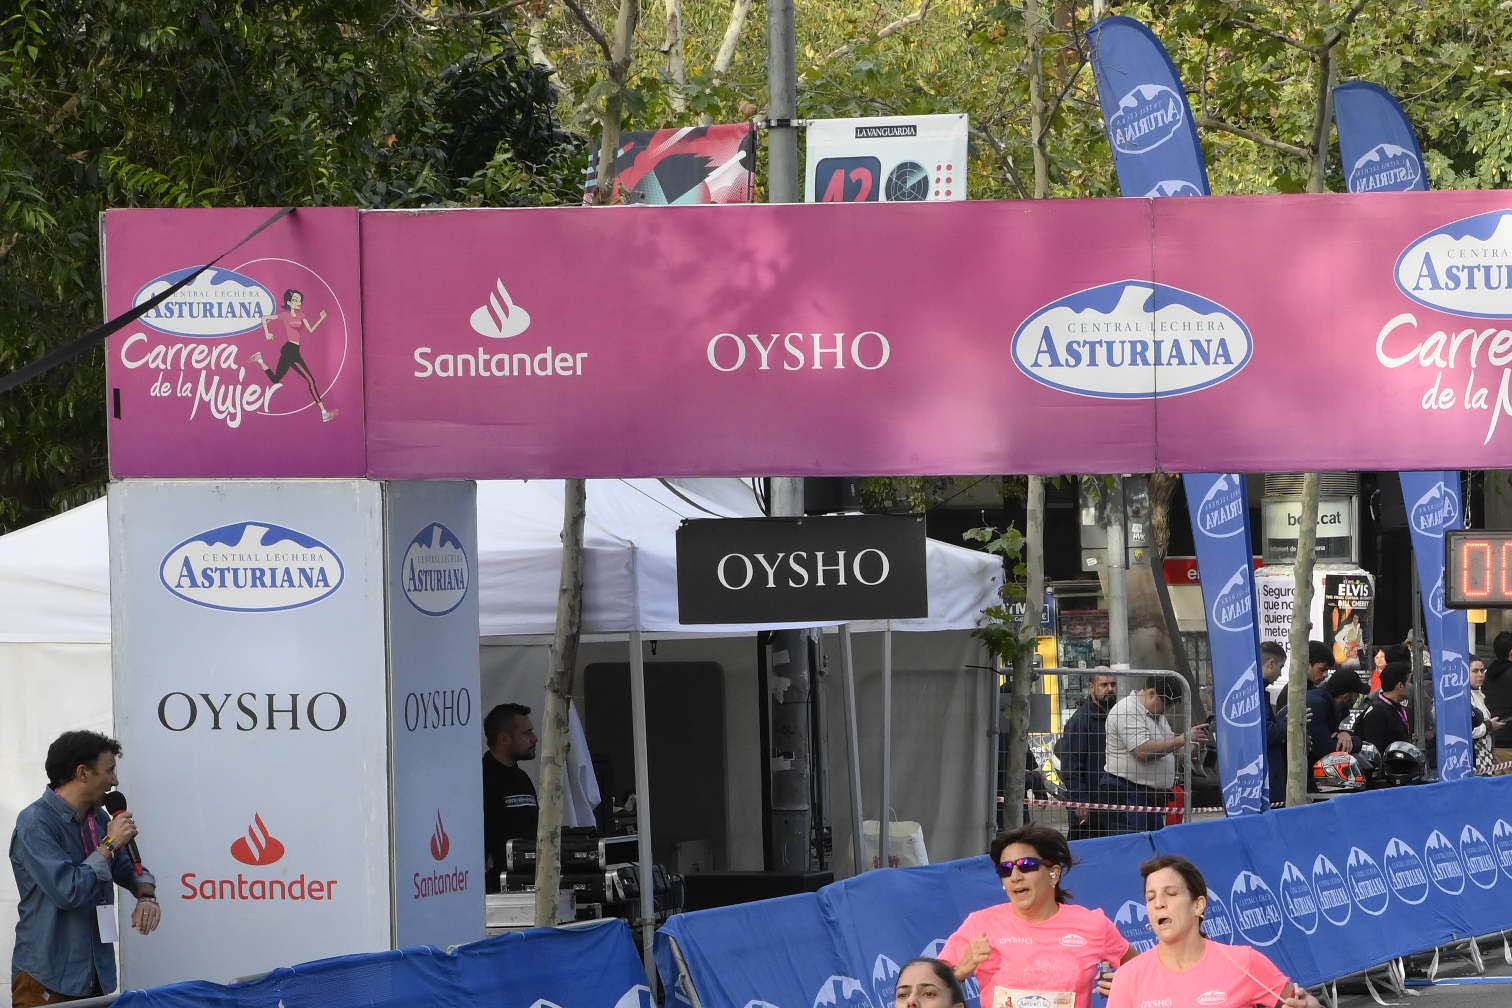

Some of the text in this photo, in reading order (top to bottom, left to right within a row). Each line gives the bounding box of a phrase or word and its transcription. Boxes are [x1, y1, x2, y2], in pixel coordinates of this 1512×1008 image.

[146, 292, 266, 320] ASTURIANA
[173, 289, 207, 299] ENTRAL
[1068, 320, 1227, 333] CENTRAL LECHERA
[121, 333, 238, 370] Carrera
[414, 346, 588, 377] Santander
[707, 331, 891, 372] OYSHO
[1030, 325, 1234, 368] ASTURIANA
[150, 367, 283, 428] de la Mujer
[1422, 378, 1454, 410] de
[1463, 373, 1488, 410] la
[174, 555, 331, 590] ASTURIANA
[202, 553, 325, 562] CENTRAL LECHERA
[717, 548, 890, 591] OYSHO
[407, 557, 465, 593] ASTURIANA
[1338, 583, 1368, 596] ELVIS
[1263, 601, 1280, 612] que
[1264, 612, 1292, 624] quiere
[157, 692, 347, 732] OYSHO
[405, 687, 471, 732] OYSHO
[181, 873, 338, 901] Santander
[413, 869, 469, 900] Santander
